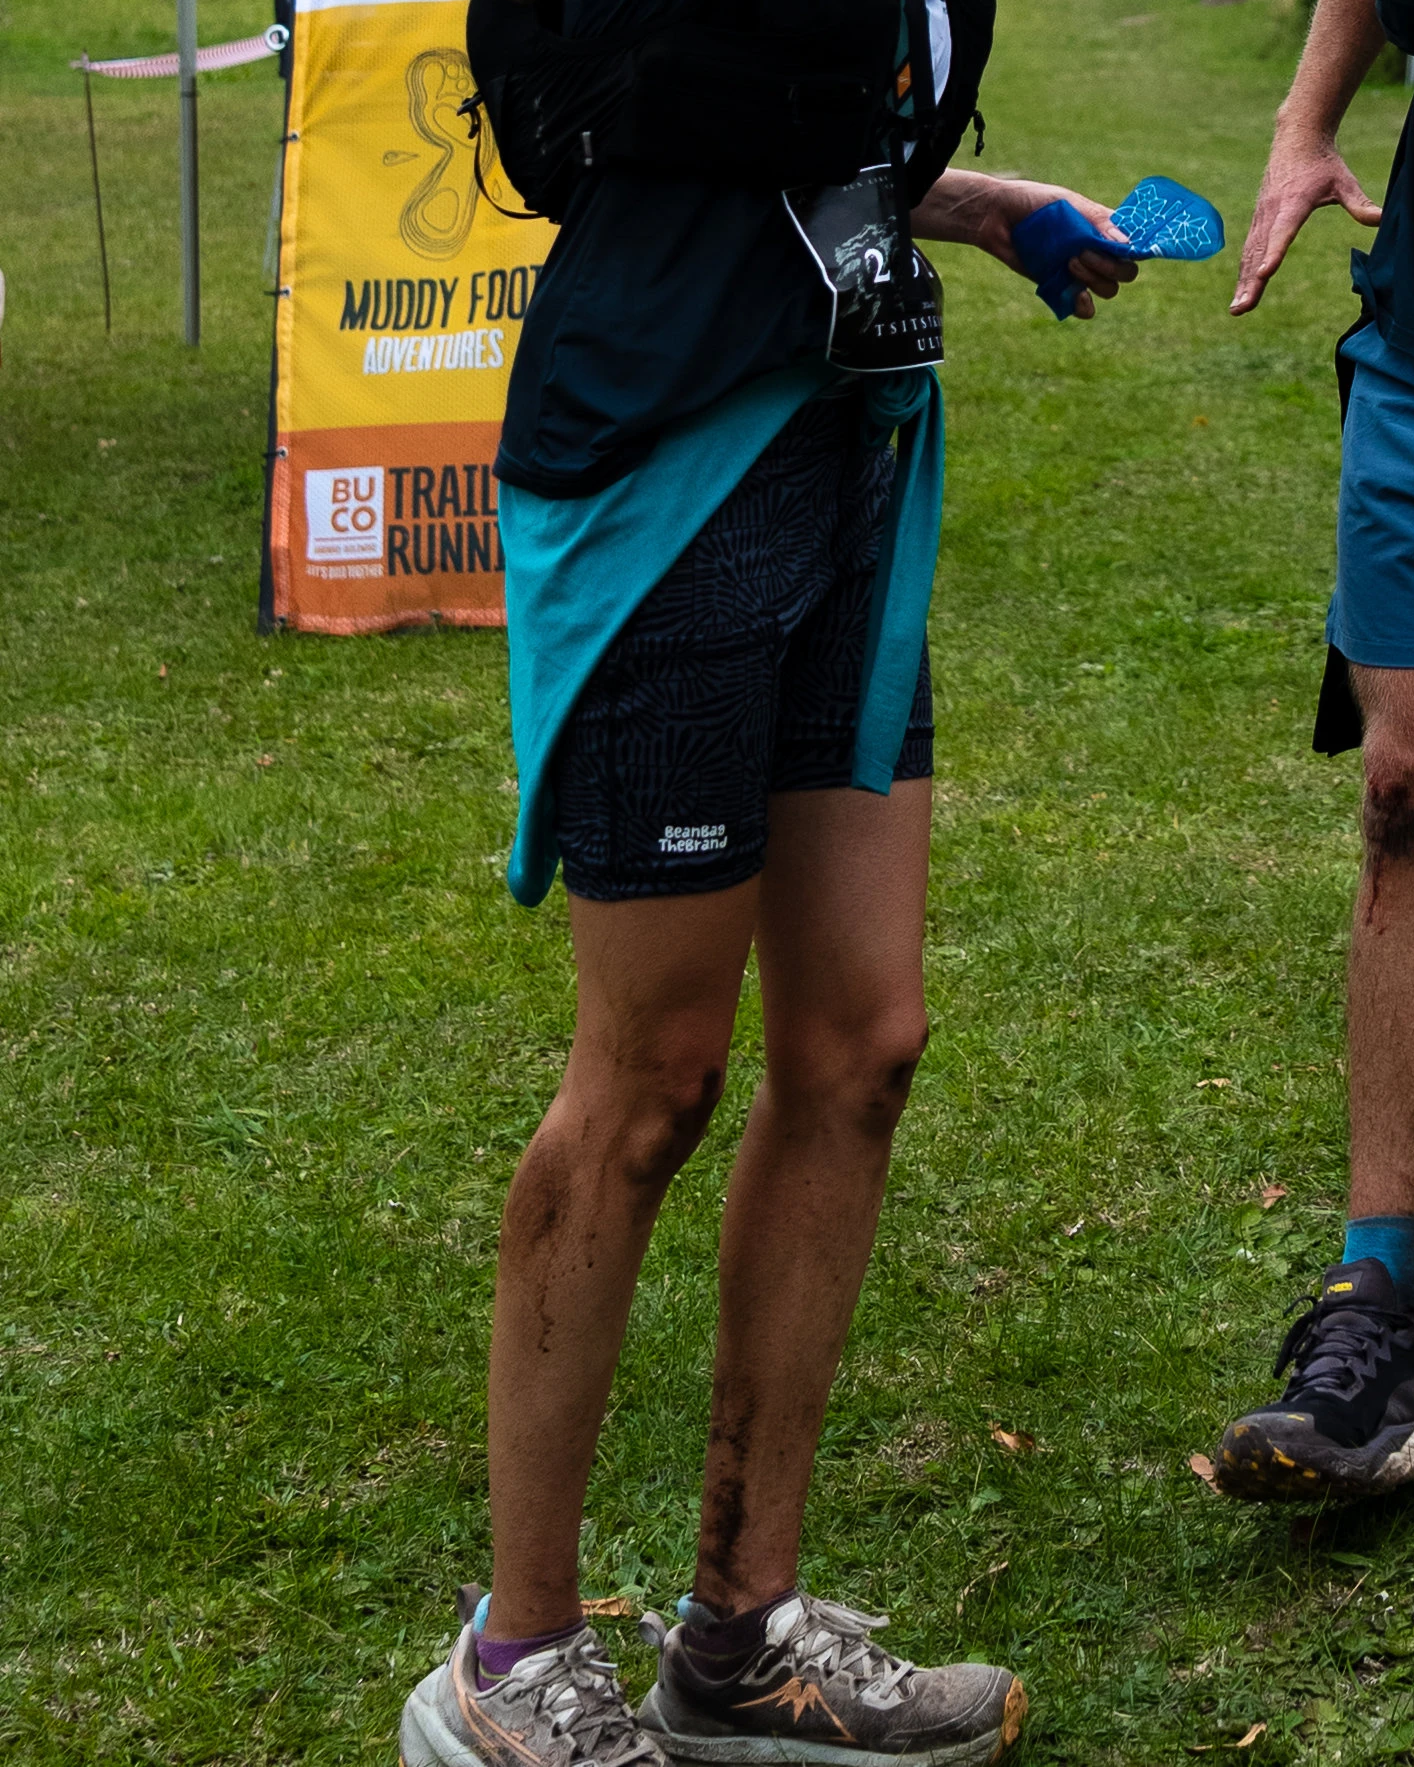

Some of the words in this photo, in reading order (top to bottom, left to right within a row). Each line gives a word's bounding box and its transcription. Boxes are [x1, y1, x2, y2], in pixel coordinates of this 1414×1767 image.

[339, 277, 458, 332] MUDDY
[362, 328, 505, 379] ADVENTURES
[331, 476, 377, 505] BU
[389, 464, 499, 521] TRAIL
[330, 505, 377, 533] CO
[657, 836, 729, 854] TheBrand
[663, 823, 727, 839] BeanBag
